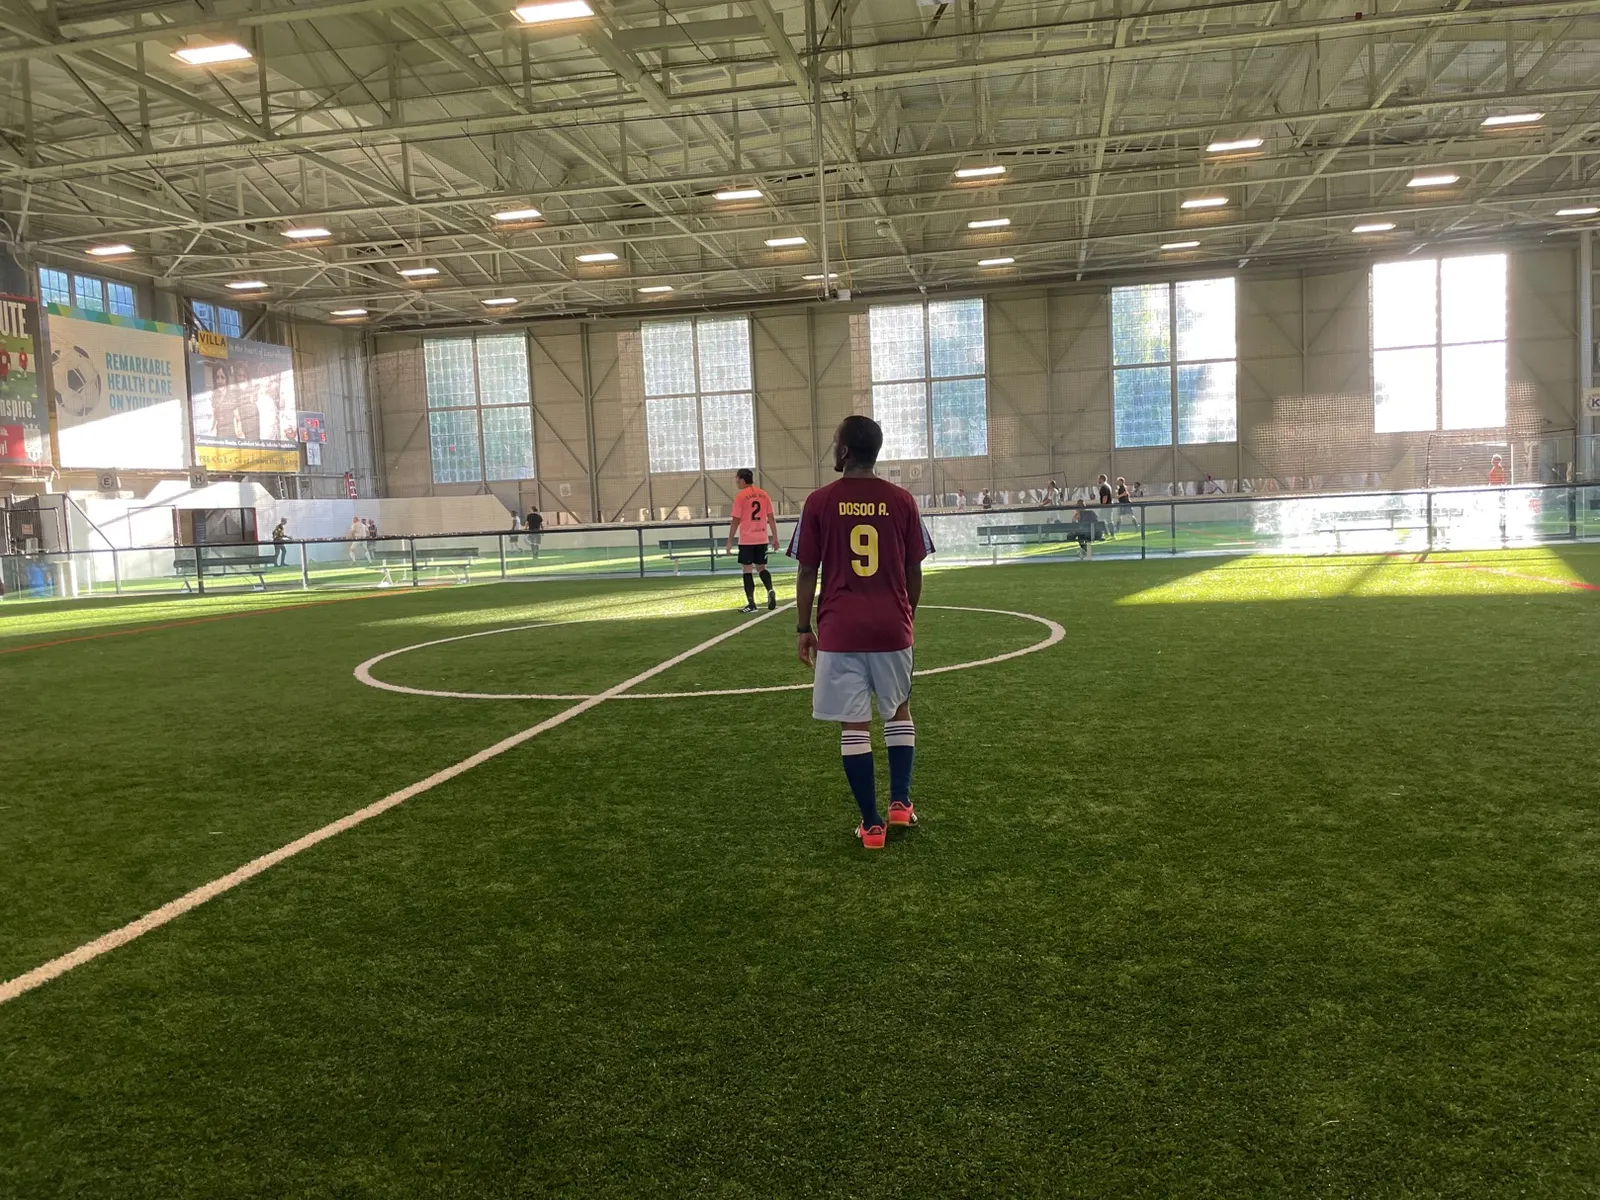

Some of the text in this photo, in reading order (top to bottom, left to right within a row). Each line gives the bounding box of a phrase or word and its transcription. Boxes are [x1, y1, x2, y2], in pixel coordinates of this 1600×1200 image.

[199, 332, 226, 347] VILLA
[105, 352, 171, 377] REMARKABLE
[108, 373, 172, 396] HEALTH CARE
[110, 393, 124, 411] ON
[195, 475, 203, 483] H
[751, 500, 761, 521] 2
[838, 502, 890, 516] DOSOO A.
[850, 524, 879, 577] 9
